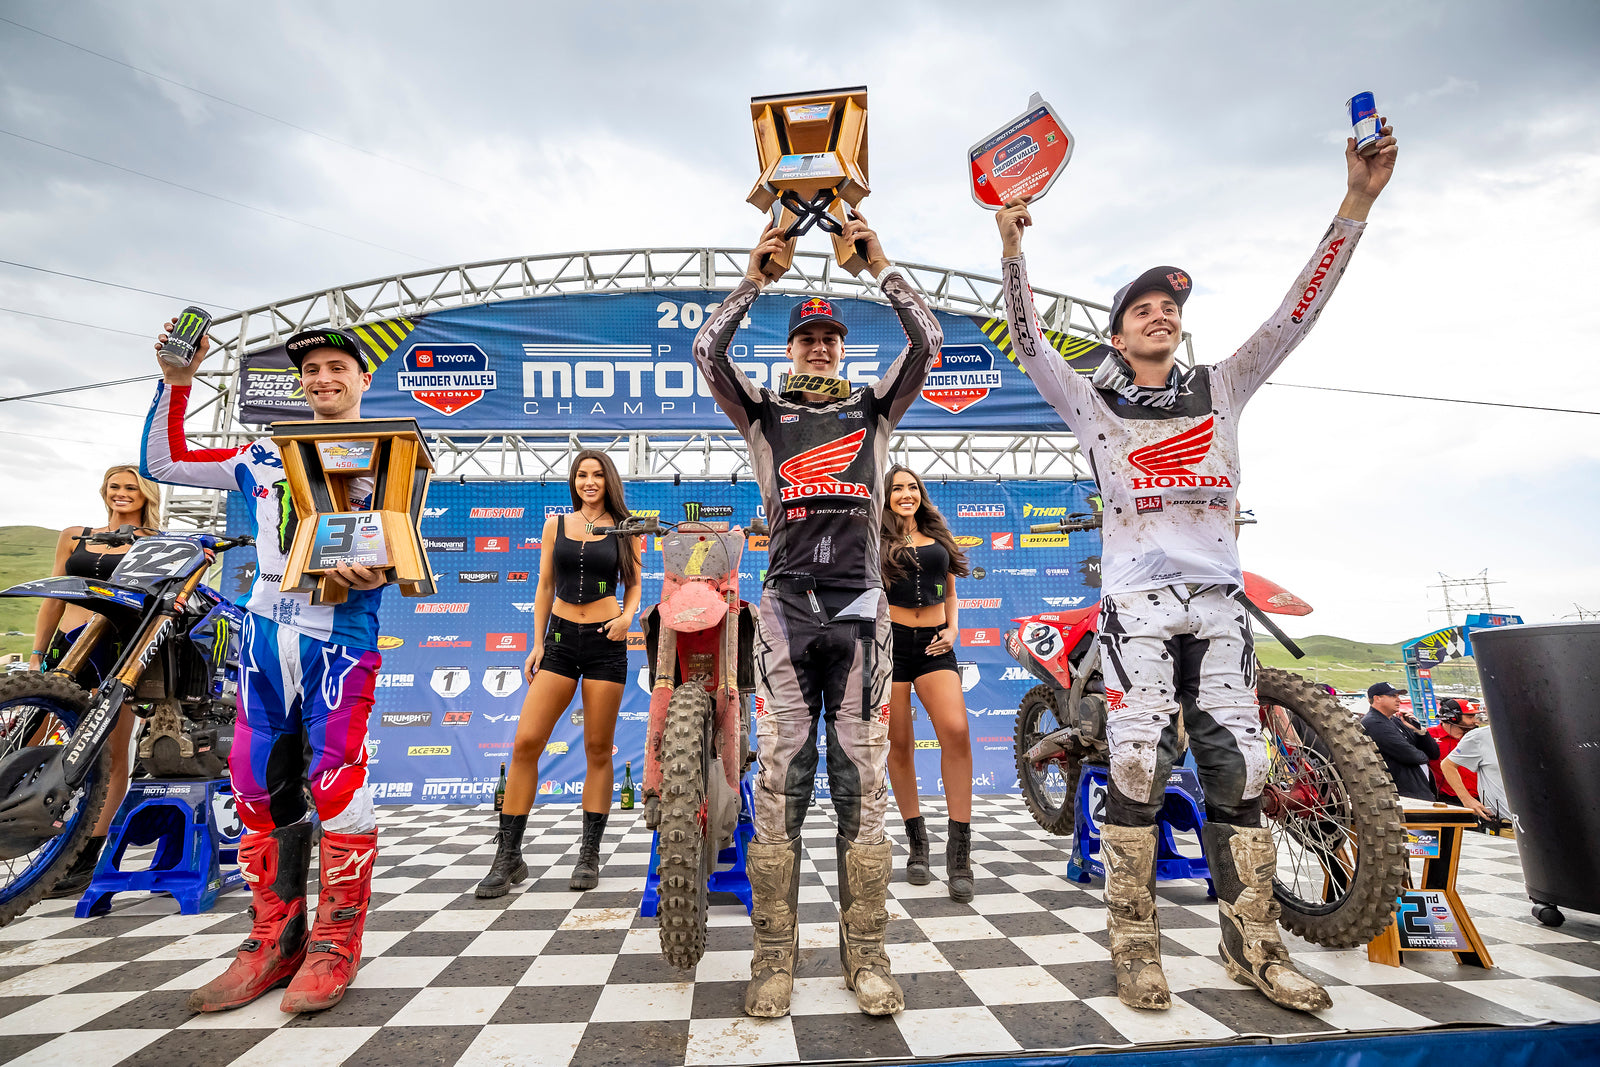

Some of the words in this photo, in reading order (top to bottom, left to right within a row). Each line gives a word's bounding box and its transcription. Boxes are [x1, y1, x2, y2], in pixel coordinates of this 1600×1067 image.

[1007, 140, 1027, 153] TOYOTA
[993, 155, 1018, 175] THUNDER
[1017, 144, 1039, 160] VALLEY
[1029, 171, 1050, 185] LEADER
[1291, 236, 1346, 320] HONDA
[801, 307, 816, 318] Red
[817, 307, 832, 317] Bull
[296, 336, 326, 348] YAMAHA
[436, 354, 476, 363] TOYOTA
[944, 355, 982, 364] TOYOTA
[247, 374, 296, 382] SUPER
[400, 375, 451, 387] THUNDER
[455, 374, 494, 387] VALLEY
[788, 374, 840, 395] 100%
[924, 374, 958, 387] UNDER
[960, 372, 999, 386] VALLEY
[245, 389, 294, 397] CROSS
[1131, 475, 1233, 490] HONDA
[780, 483, 871, 501] HONDA
[958, 504, 1004, 512] PARTS
[1137, 498, 1160, 509] ヨシムラ
[1033, 507, 1067, 517] THOR
[320, 514, 373, 555] 3rd
[429, 541, 464, 549] Husqvarna
[119, 542, 198, 577] 32
[392, 674, 414, 683] PRO
[382, 714, 421, 722] TRIUMPH
[67, 699, 110, 764] DUNLOP
[388, 782, 414, 792] PRO
[1093, 787, 1107, 822] 2
[223, 797, 244, 838] 3
[1401, 894, 1439, 934] 2nd
